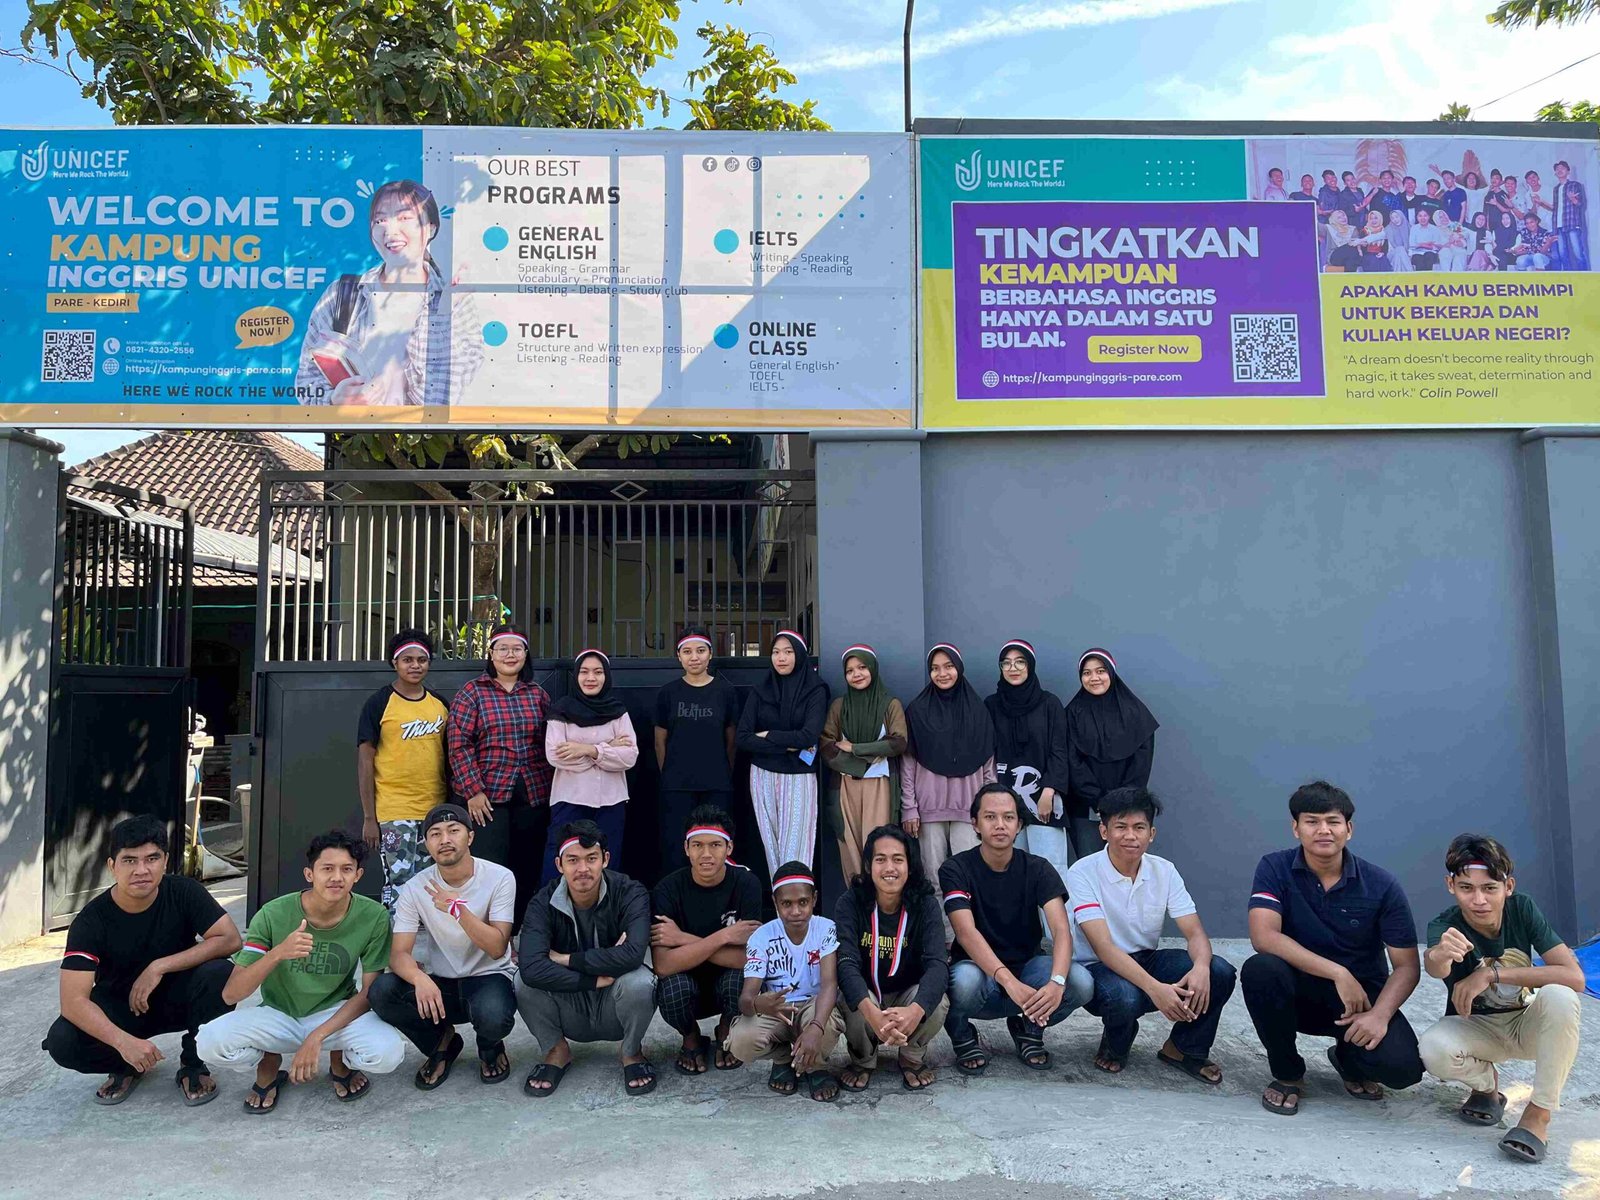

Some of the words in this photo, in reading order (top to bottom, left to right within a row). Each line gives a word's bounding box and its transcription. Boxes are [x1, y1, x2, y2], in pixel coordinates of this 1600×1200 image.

[54, 150, 129, 169] UNICEF
[488, 159, 532, 177] OUR
[536, 160, 580, 177] BEST
[987, 160, 1065, 178] UNICEF
[487, 185, 620, 205] PROGRAMS
[48, 196, 280, 226] WELCOME
[293, 196, 354, 228] TO
[518, 226, 604, 241] GENERAL
[750, 231, 798, 246] IELTS
[50, 234, 261, 262] KAMPUNG
[976, 226, 1259, 259] TINGKATKAN
[518, 245, 597, 260] ENGLISH
[750, 252, 789, 264] Writing
[800, 253, 850, 265] Speaking
[518, 263, 567, 275] Speaking
[578, 264, 631, 273] Grammar
[750, 263, 799, 276] Listening
[810, 264, 853, 276] Reading
[980, 263, 1178, 285] KEMAMPUAN
[48, 265, 187, 288] INGGRIS
[200, 267, 326, 290] UNICEF
[518, 274, 580, 285] Vocabulary
[592, 275, 668, 285] Pronunciation
[518, 285, 567, 296] Listening
[580, 285, 618, 295] Debate
[629, 285, 661, 297] Study
[664, 286, 688, 296] club
[980, 289, 1122, 306] BERBAHASA
[1126, 288, 1217, 305] INGGRIS
[1340, 285, 1418, 298] APAKAH
[1424, 285, 1478, 297] KAMU
[1484, 284, 1574, 297] BERMIMPI
[54, 298, 82, 308] PARE
[93, 298, 130, 307] KEDIRI
[980, 310, 1062, 327] HANYA
[1067, 310, 1149, 326] DALAM
[1154, 310, 1214, 326] SATU
[1342, 307, 1405, 320] UNTUK
[1410, 306, 1494, 319] BEKERJA
[1500, 305, 1539, 318] DAN
[240, 316, 290, 327] REGISTER
[250, 328, 275, 337] NOW
[518, 323, 578, 338] TOEFL
[749, 322, 817, 337] ONLINE
[1343, 329, 1412, 342] KULIAH
[1418, 328, 1490, 341] KELUAR
[1496, 327, 1571, 340] NEGERI?
[981, 331, 1066, 348] BULAN.
[125, 346, 194, 354] 0821-4320-2556
[517, 343, 571, 352] Structure
[574, 343, 594, 352] and
[598, 343, 639, 353] Written
[642, 344, 703, 356] expression
[749, 341, 808, 356] CLASS
[1099, 344, 1155, 357] Register
[1159, 344, 1190, 355] Now
[517, 354, 567, 366] Listening
[578, 354, 622, 366] Reading
[1344, 355, 1357, 365] "A
[1360, 354, 1401, 365] dream
[1404, 353, 1450, 364] doesn't
[1452, 353, 1502, 364] become
[1505, 352, 1541, 365] reality
[1544, 352, 1594, 366] through
[125, 364, 292, 376] https://kampunginggris-pare.com
[750, 360, 791, 370] General
[796, 360, 835, 373] English
[750, 371, 784, 381] TOEFL
[1003, 372, 1183, 385] https://kampunginggris-pare.com
[1345, 371, 1387, 384] magic,
[1390, 371, 1398, 381] it
[1401, 370, 1435, 381] takes
[1438, 371, 1477, 382] sweat,
[1479, 369, 1565, 380] determination
[1568, 369, 1592, 380] and
[123, 385, 161, 397] HERE
[168, 386, 189, 397] WE
[195, 386, 232, 397] ROCK
[240, 386, 266, 398] THE
[272, 386, 325, 398] WORLD
[750, 382, 779, 392] IELTS
[1346, 388, 1374, 399] hard
[1378, 387, 1416, 398] work."
[1420, 388, 1452, 398] Colin
[1455, 387, 1499, 398] Powell
[400, 714, 444, 740] Think
[290, 961, 325, 975] FACE
